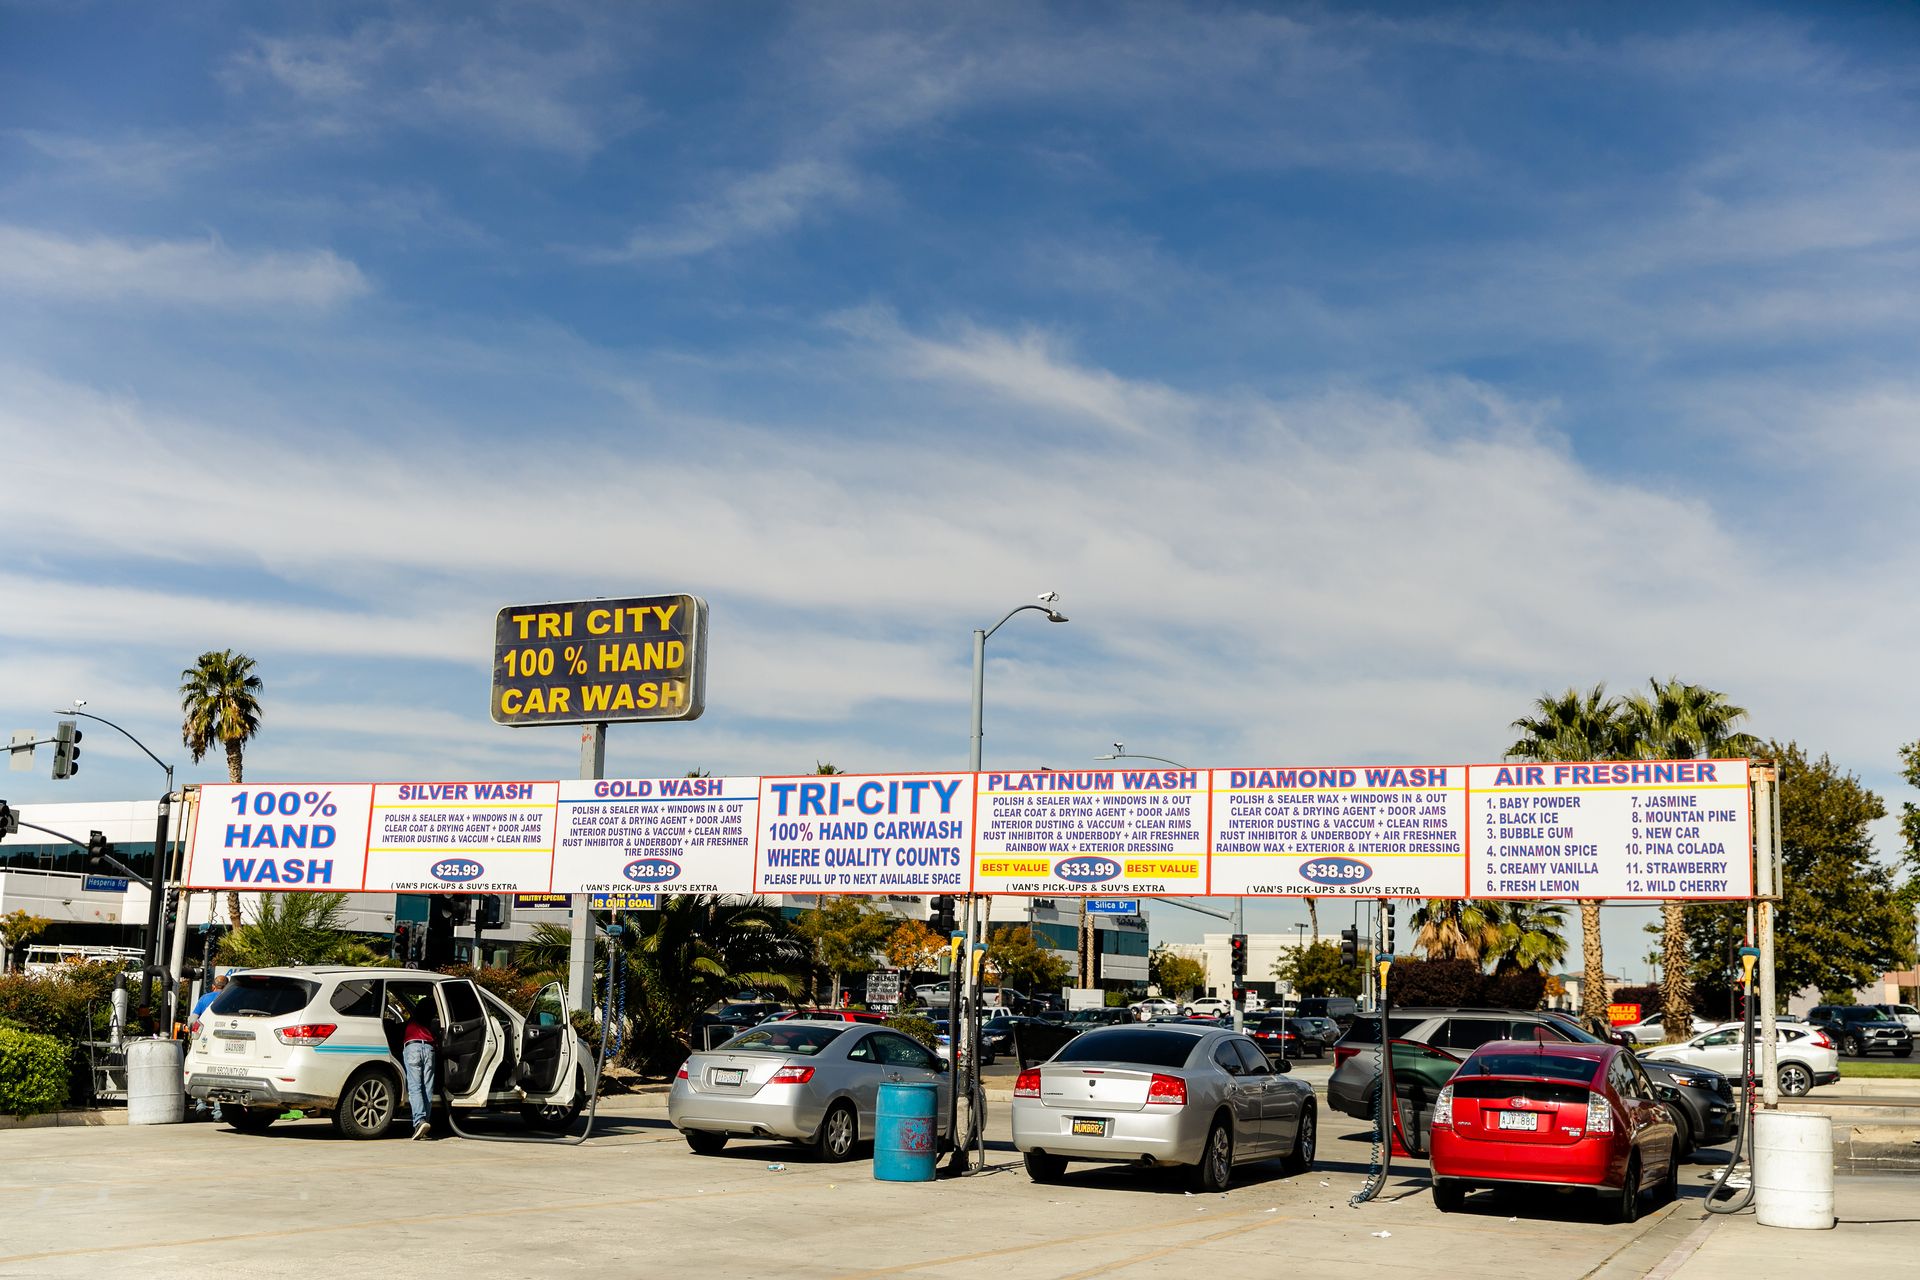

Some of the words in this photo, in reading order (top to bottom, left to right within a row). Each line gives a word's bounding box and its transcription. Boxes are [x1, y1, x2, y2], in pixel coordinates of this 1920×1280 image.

[512, 611, 573, 640] TRI
[586, 605, 679, 635] CITY
[503, 648, 555, 678] 100
[564, 646, 588, 676] %
[599, 640, 685, 673] HAND
[501, 687, 571, 715] CAR
[581, 682, 684, 712] WASH
[1231, 770, 1356, 789] DIAMOND
[1364, 768, 1447, 787] WASH
[1494, 767, 1545, 786] AIR
[1554, 763, 1718, 785] FRESHNER
[988, 773, 1114, 791] PLATINUM
[1122, 772, 1197, 789] WASH
[398, 785, 467, 800] SILVER
[475, 784, 533, 800] WASH
[594, 781, 652, 798] GOLD
[659, 779, 723, 796] WASH
[771, 780, 962, 816] TRI-CITY
[1230, 795, 1264, 804] POLISH
[1267, 795, 1274, 804] &
[1277, 795, 1314, 804] SEALER
[1317, 794, 1339, 803] WAX
[1350, 794, 1398, 803] WINDOWS
[1402, 794, 1412, 803] IN
[1415, 794, 1422, 803] &
[1426, 794, 1447, 803] OUT
[1487, 798, 1496, 809] 1.
[1500, 797, 1529, 809] BABY
[1533, 796, 1580, 808] POWDER
[1631, 796, 1641, 808] 7.
[1645, 796, 1697, 808] JASMINE
[232, 792, 337, 817] 100%
[993, 808, 1021, 817] CLEAR
[1024, 808, 1047, 817] COAT
[1050, 808, 1056, 817] &
[1059, 808, 1093, 817] DRYING
[1095, 808, 1126, 817] AGENT
[1137, 808, 1162, 816] DOOR
[1165, 807, 1190, 816] JAMS
[1486, 813, 1496, 824] 2.
[1500, 813, 1536, 824] BLACK
[1540, 812, 1558, 824] ICE
[1632, 811, 1642, 823] 8.
[1646, 811, 1704, 823] MOUNTAN
[1708, 810, 1736, 822] PINE
[224, 824, 336, 848] HAND
[770, 822, 813, 841] 100%
[819, 822, 868, 840] HAND
[874, 821, 962, 840] CARWASH
[1220, 831, 1245, 840] RUST
[1248, 831, 1297, 840] INHIBITOR
[1301, 831, 1307, 840] &
[1311, 831, 1371, 840] UNDERBODY
[1383, 831, 1400, 840] AIR
[1403, 831, 1457, 840] FRESHNER
[1487, 828, 1496, 839] 3.
[1500, 827, 1544, 839] BUBBLE
[1548, 827, 1573, 839] GUM
[1632, 827, 1642, 839] 9.
[1646, 827, 1672, 839] NEW
[1676, 827, 1700, 839] CAR
[382, 835, 415, 843] INTERIOR
[417, 835, 449, 843] DUSTING
[451, 835, 456, 843] &
[458, 835, 488, 843] VACCUM
[497, 835, 521, 843] CLEAN
[523, 835, 541, 843] RIMS
[624, 848, 642, 856] TIRE
[644, 848, 683, 856] DRESSING
[1006, 843, 1047, 852] RAINBOW
[1049, 843, 1069, 852] WAX
[1080, 843, 1124, 853] EXTERIOR
[1127, 843, 1173, 852] DRESSING
[1216, 843, 1261, 853] RAINBOW
[1263, 843, 1285, 852] WAX
[1296, 843, 1346, 854] EXTERIOR
[1348, 843, 1355, 852] &
[1359, 843, 1406, 852] INTERIOR
[1409, 843, 1460, 854] DRESSING
[1487, 845, 1496, 857] 4.
[1500, 845, 1560, 857] CINNAMON
[1564, 845, 1597, 856] SPICE
[1625, 843, 1642, 855] 10.
[1646, 843, 1674, 855] PINA
[1677, 843, 1725, 854] COLADA
[768, 848, 820, 867] WHERE
[825, 848, 891, 868] QUALITY
[896, 847, 960, 866] COUNTS
[223, 858, 333, 884] WASH
[436, 864, 479, 877] $25.99
[629, 865, 675, 878] $28.99
[982, 864, 1010, 872] BEST
[1013, 864, 1047, 872] VALUE
[1061, 863, 1115, 877] $33.99
[1127, 864, 1156, 873] BEST
[1160, 864, 1196, 873] VALUE
[1306, 863, 1365, 879] $38.99
[1487, 863, 1496, 874] 5.
[1500, 863, 1547, 874] CREAMY
[1550, 862, 1599, 874] VANILLA
[1626, 862, 1643, 874] 11.
[1646, 862, 1727, 874] STRAWBERRY
[88, 878, 116, 887] Hesperia
[764, 874, 797, 885] PLEASE
[800, 874, 822, 884] PULL
[824, 874, 836, 884] UP
[839, 874, 851, 884] TO
[853, 874, 877, 884] NEXT
[880, 873, 929, 884] AVAILABLE
[932, 873, 961, 884] SPACE
[1339, 886, 1346, 894] &
[1350, 886, 1381, 894] SUV'S
[1487, 880, 1496, 892] 6.
[1500, 880, 1536, 892] FRESH
[1540, 880, 1579, 891] LEMON
[1627, 880, 1643, 892] 12.
[1646, 880, 1676, 892] WILD
[1680, 880, 1728, 892] CHERRY
[594, 899, 604, 908] IS
[1095, 901, 1115, 909] Silica
[1119, 901, 1127, 909] Dr
